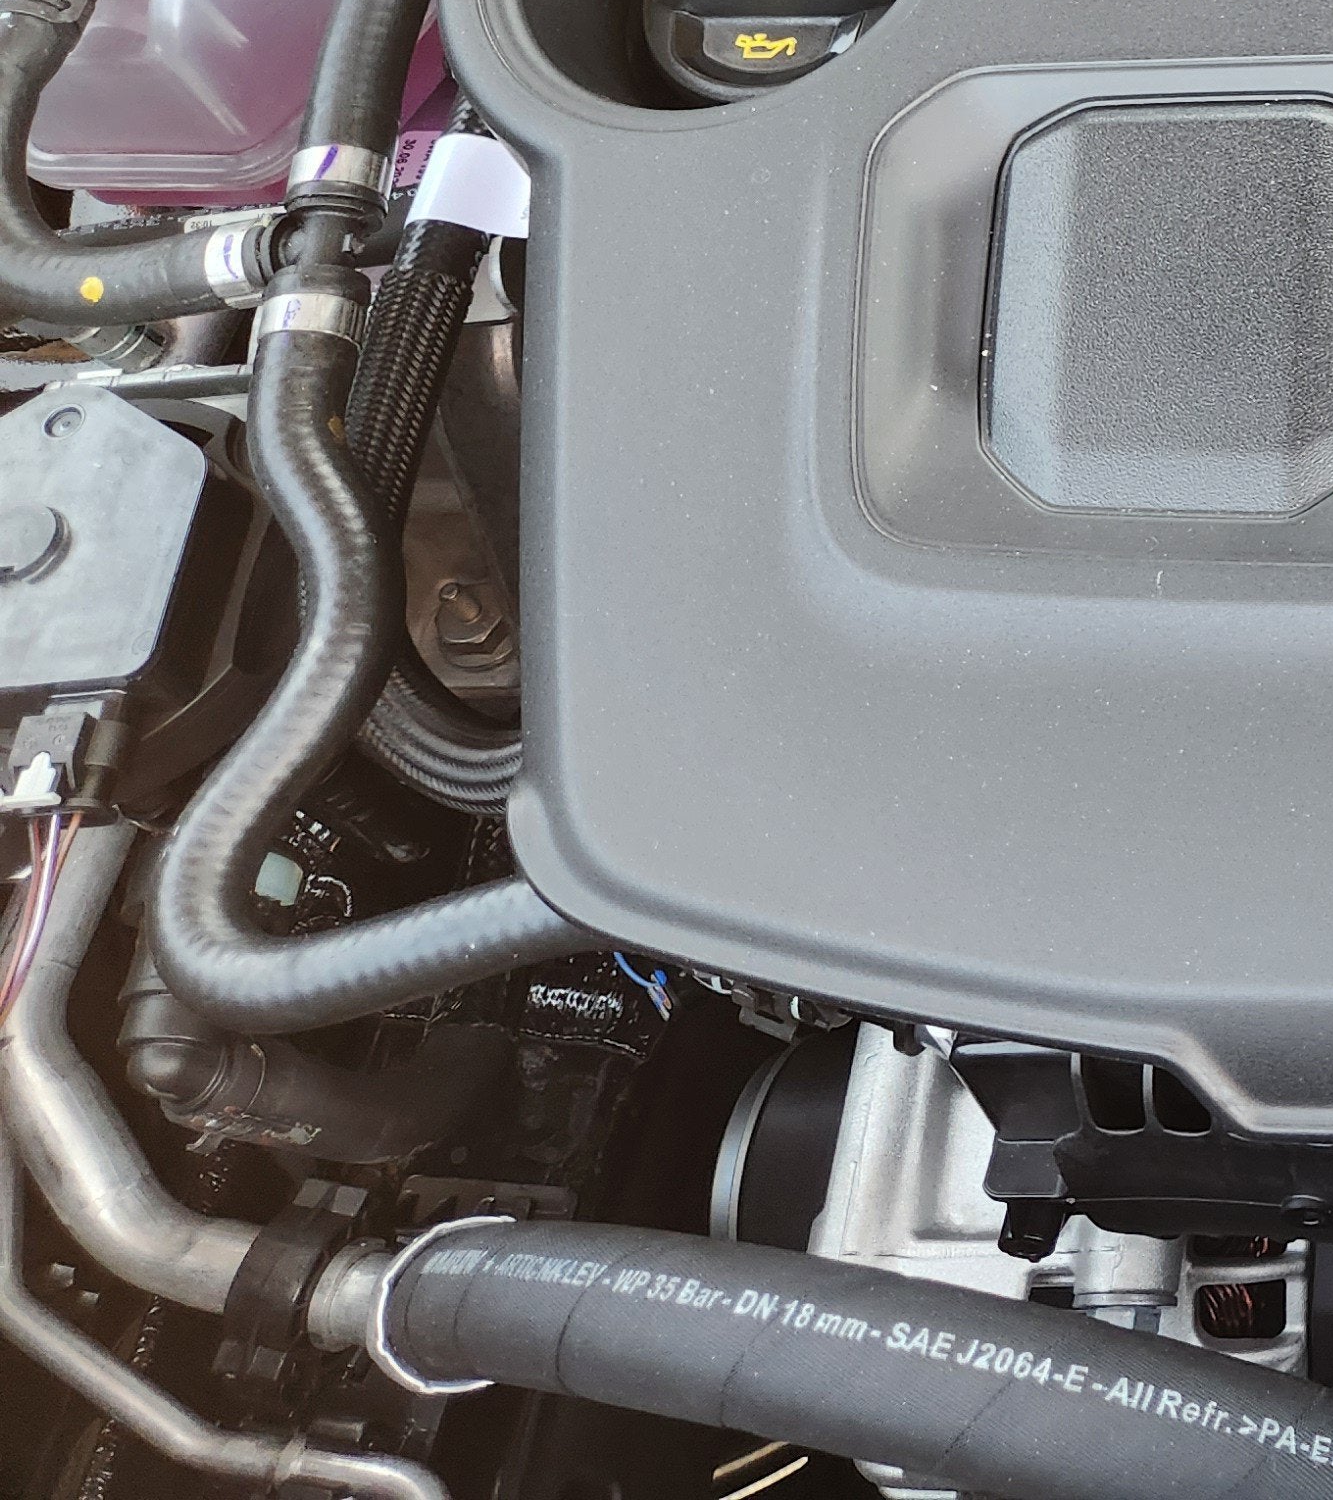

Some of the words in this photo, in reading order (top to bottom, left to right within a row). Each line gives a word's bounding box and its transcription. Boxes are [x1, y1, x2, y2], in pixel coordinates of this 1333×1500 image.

[611, 1267, 651, 1295] WP
[647, 1273, 681, 1301] 35
[733, 1288, 780, 1321] DN
[781, 1299, 816, 1329] 18
[885, 1322, 956, 1361] SAE
[956, 1338, 1090, 1393] J2064-E
